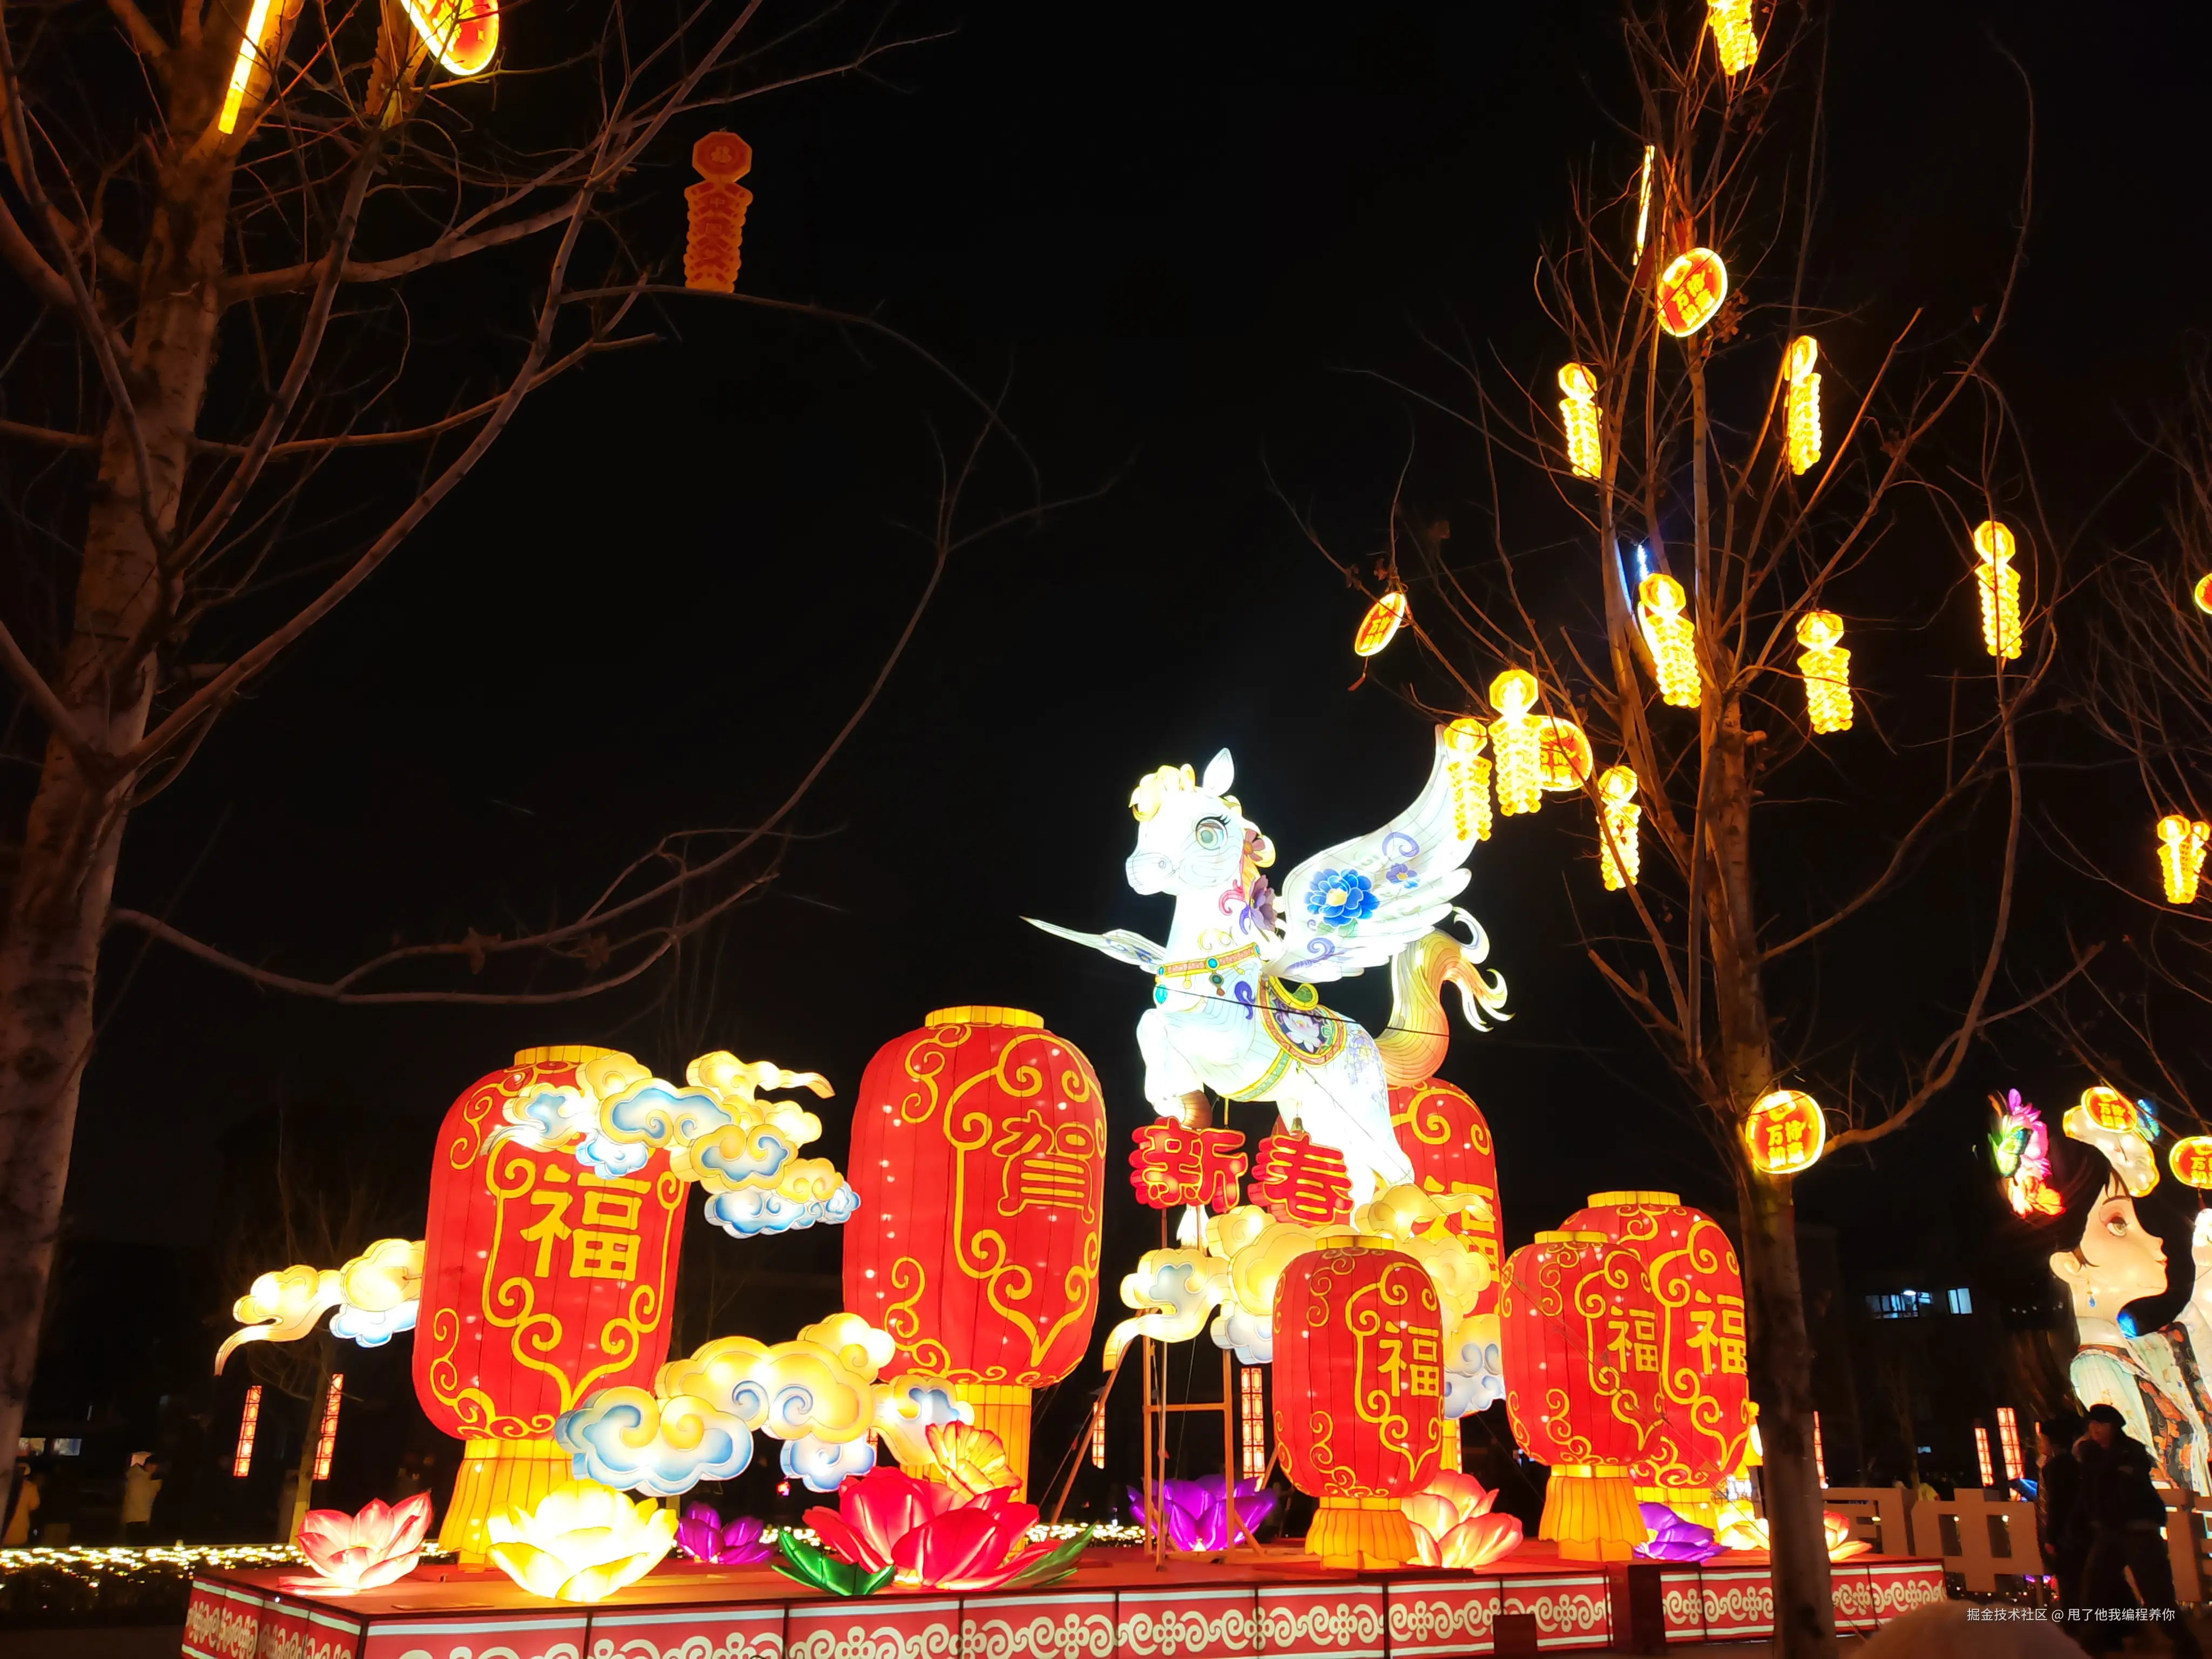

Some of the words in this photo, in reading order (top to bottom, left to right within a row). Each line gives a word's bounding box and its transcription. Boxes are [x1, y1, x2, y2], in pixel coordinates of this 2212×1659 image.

[521, 1164, 651, 1282] 福
[1377, 1326, 1440, 1398] 福
[1607, 1306, 1660, 1373] 福
[1686, 1289, 1748, 1375] 福
